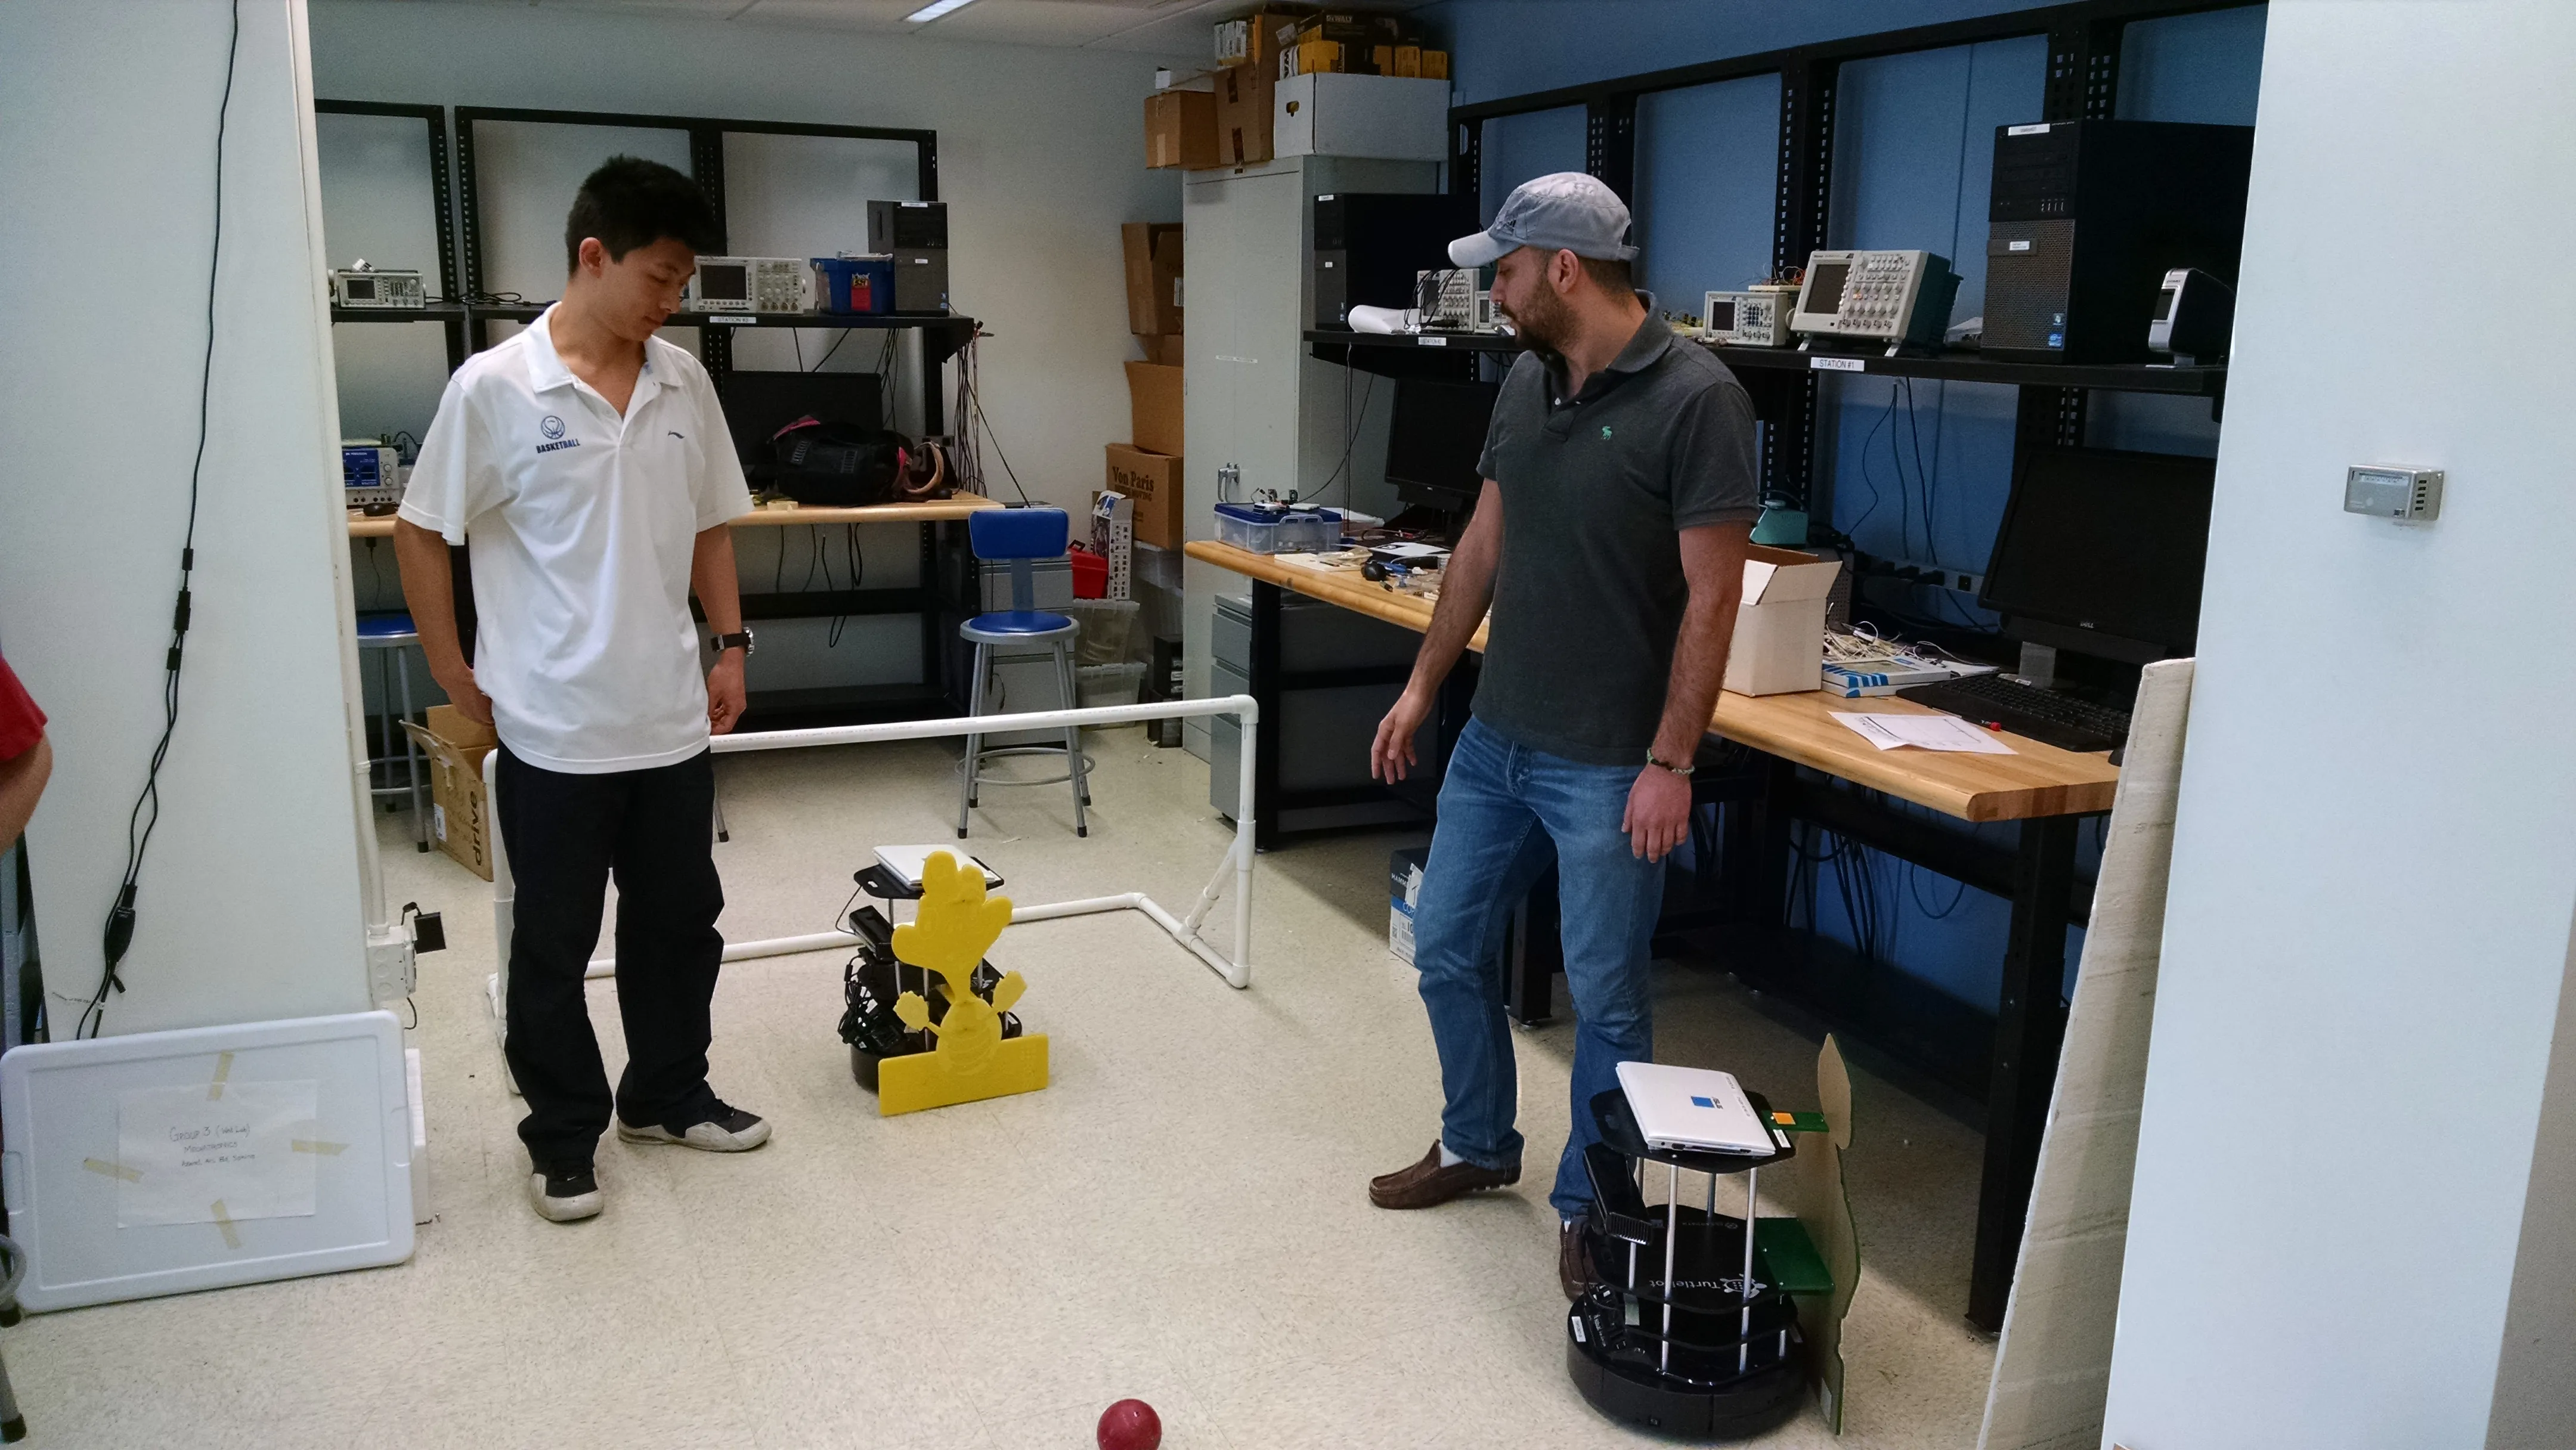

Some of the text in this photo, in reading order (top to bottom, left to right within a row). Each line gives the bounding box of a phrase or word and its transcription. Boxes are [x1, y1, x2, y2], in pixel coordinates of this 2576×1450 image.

[1819, 359, 1846, 368] STATION
[536, 438, 580, 454] BASKETBALL
[1112, 466, 1129, 486] Von
[1131, 470, 1154, 492] Paris
[470, 791, 482, 866] drive
[203, 1126, 211, 1137] 3
[1649, 1280, 1722, 1289] Turtleot
